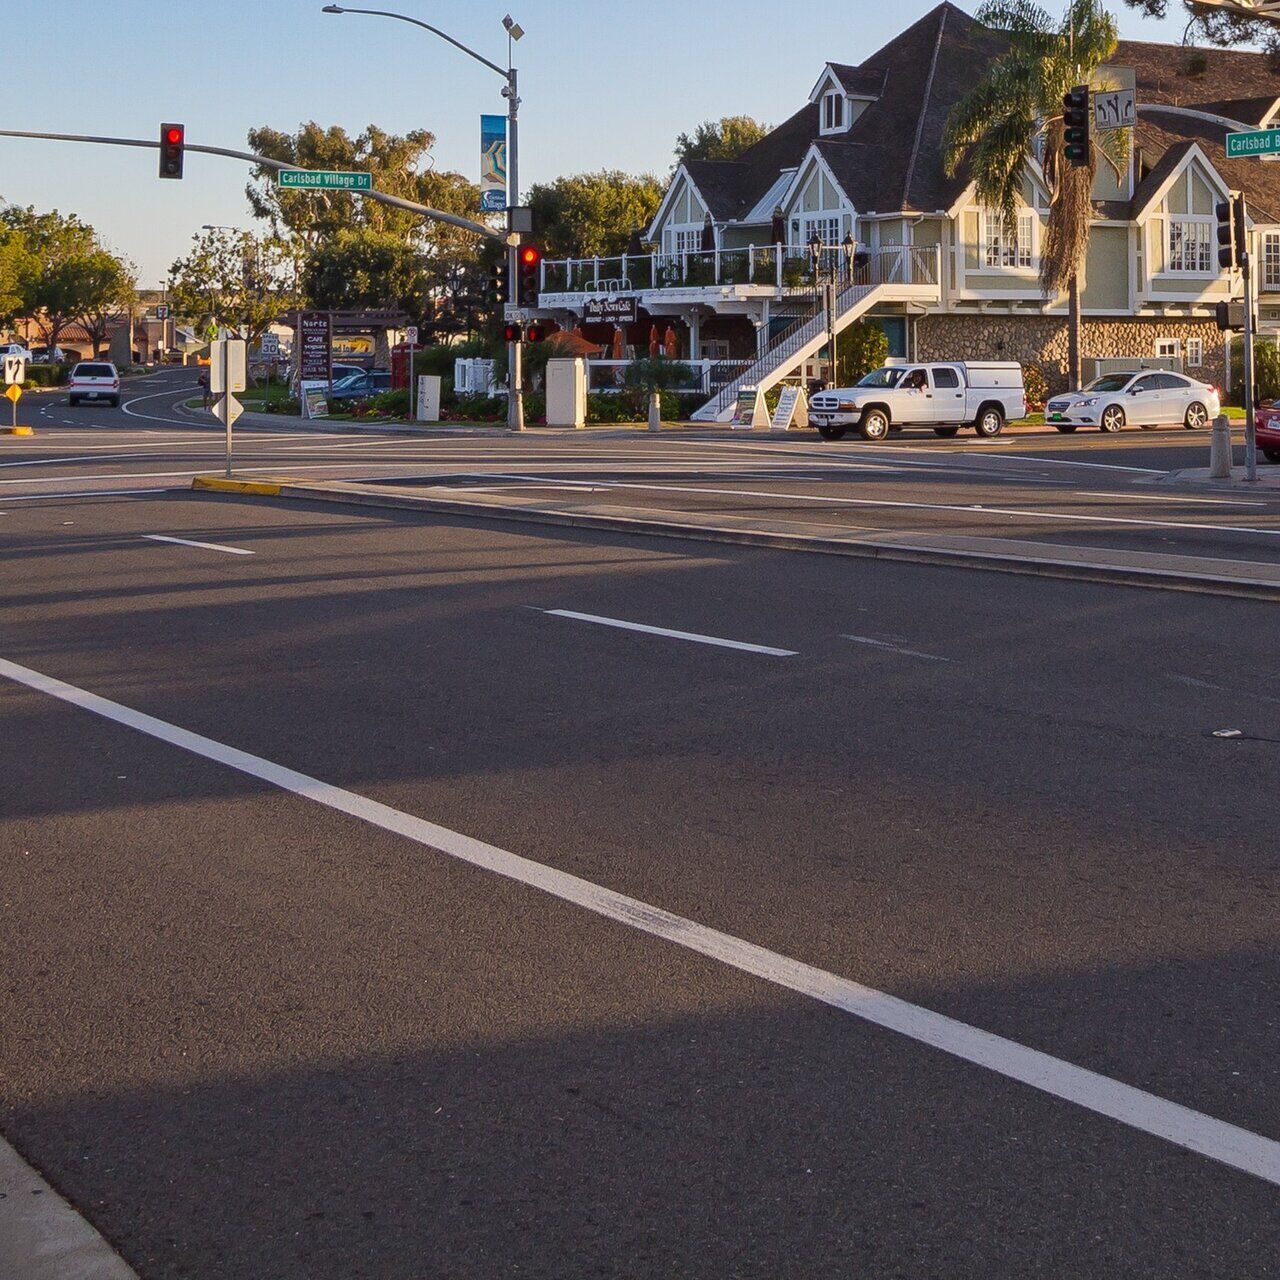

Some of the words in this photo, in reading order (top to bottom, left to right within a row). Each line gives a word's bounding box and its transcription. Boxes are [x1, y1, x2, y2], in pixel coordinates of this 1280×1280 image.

[1230, 136, 1271, 152] Carlsbad
[282, 173, 321, 184] Carlsbad
[324, 174, 355, 187] Village
[357, 176, 368, 186] Dr
[263, 344, 277, 353] 30
